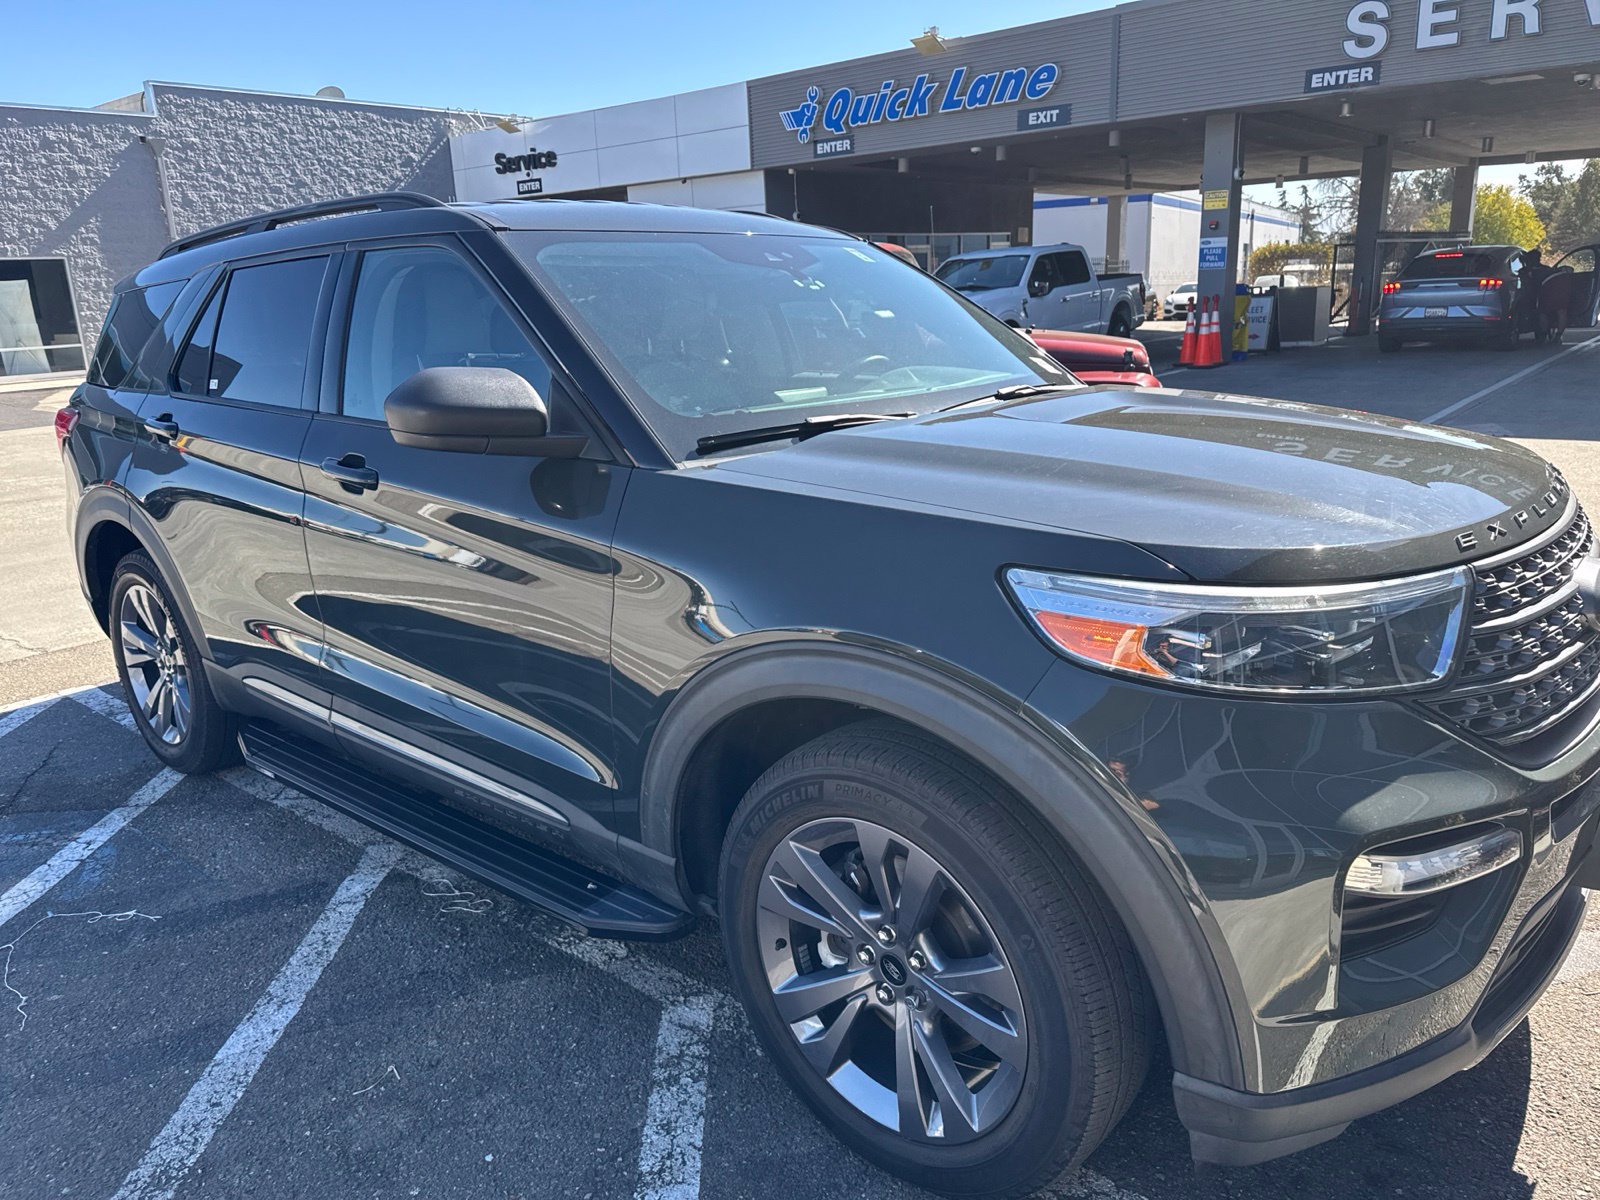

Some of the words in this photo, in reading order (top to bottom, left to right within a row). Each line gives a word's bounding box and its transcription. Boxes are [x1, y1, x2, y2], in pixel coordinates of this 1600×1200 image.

[1342, 0, 1600, 59] SER
[1310, 66, 1374, 88] ENTER
[823, 73, 939, 135] Quick
[939, 62, 1059, 113] Lane
[1028, 109, 1060, 125] EXIT
[816, 139, 850, 155] ENTER
[494, 147, 558, 175] Service
[519, 181, 541, 192] ENTER
[1247, 306, 1264, 314] LEET
[751, 784, 820, 836] MICHELIN
[835, 783, 892, 807] PRIMACY
